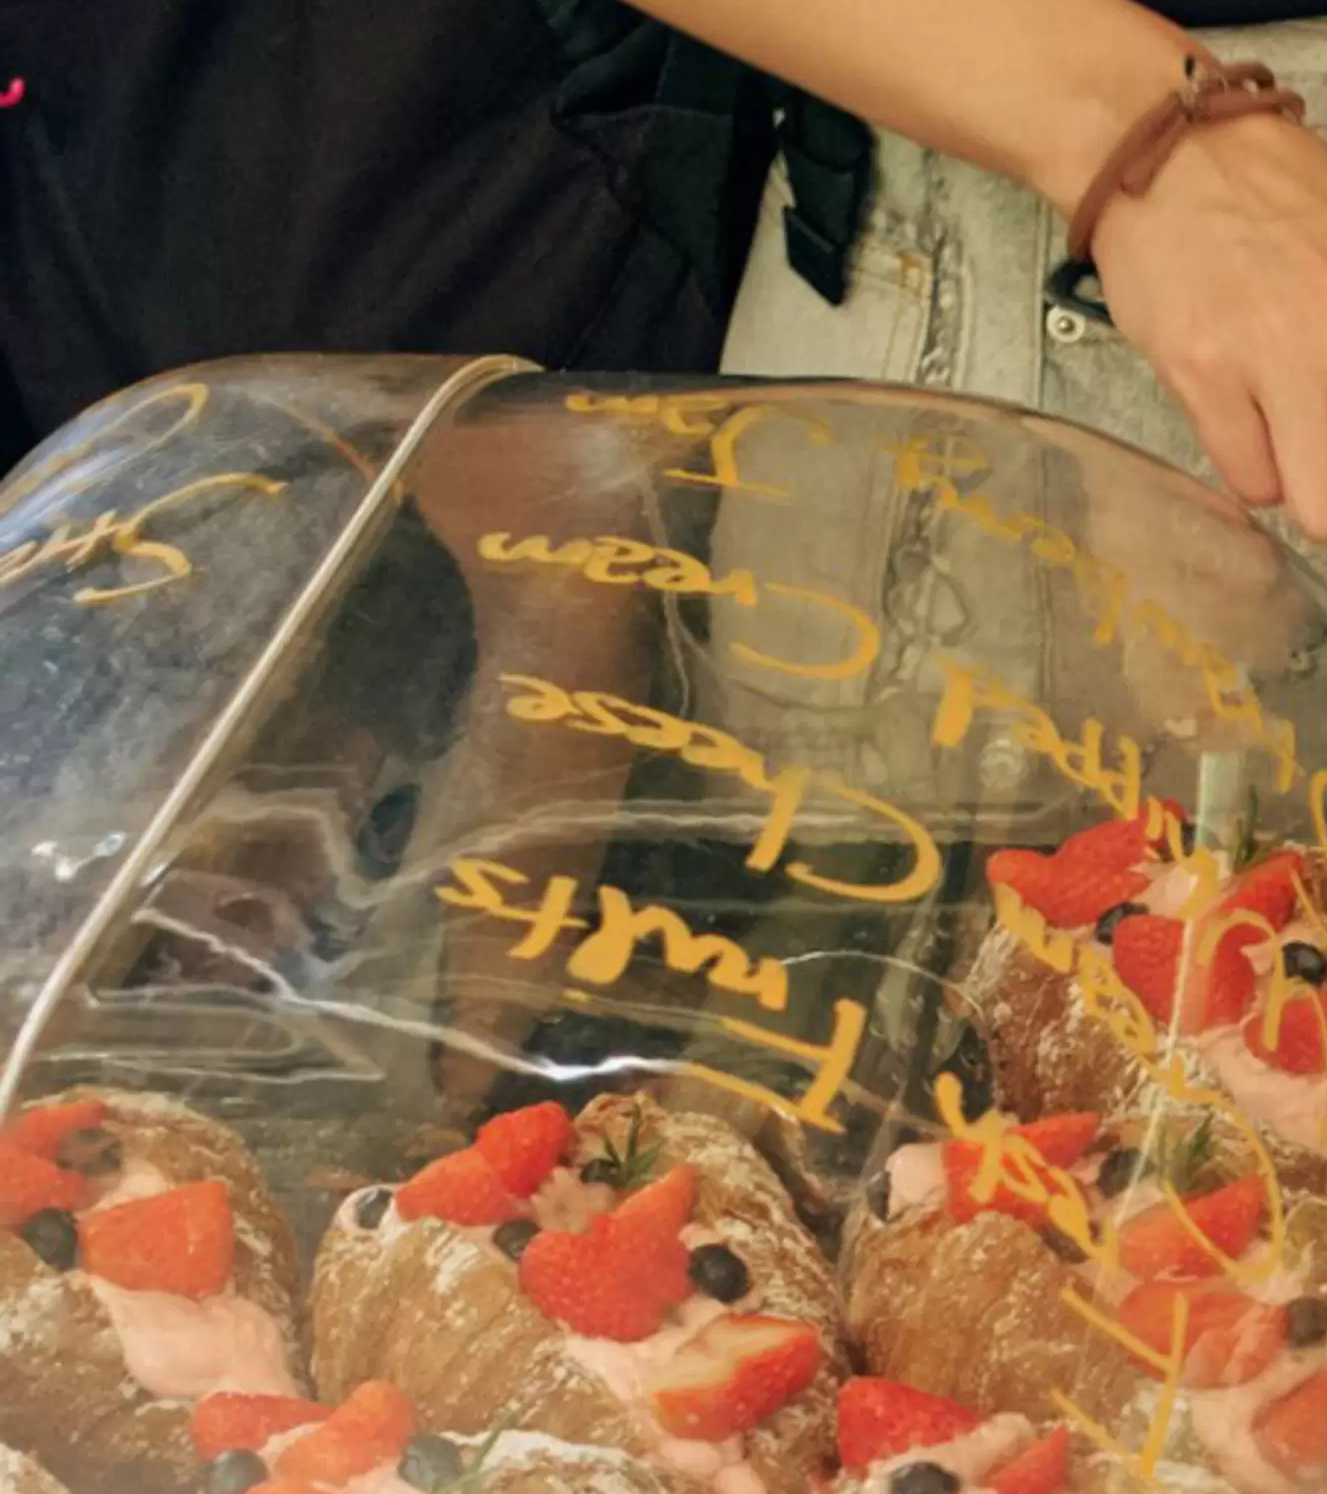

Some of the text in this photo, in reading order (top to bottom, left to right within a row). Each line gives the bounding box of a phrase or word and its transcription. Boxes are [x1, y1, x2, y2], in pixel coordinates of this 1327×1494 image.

[478, 531, 882, 680] Cream
[498, 672, 943, 901] Cheese
[432, 856, 868, 1135] Fruits
